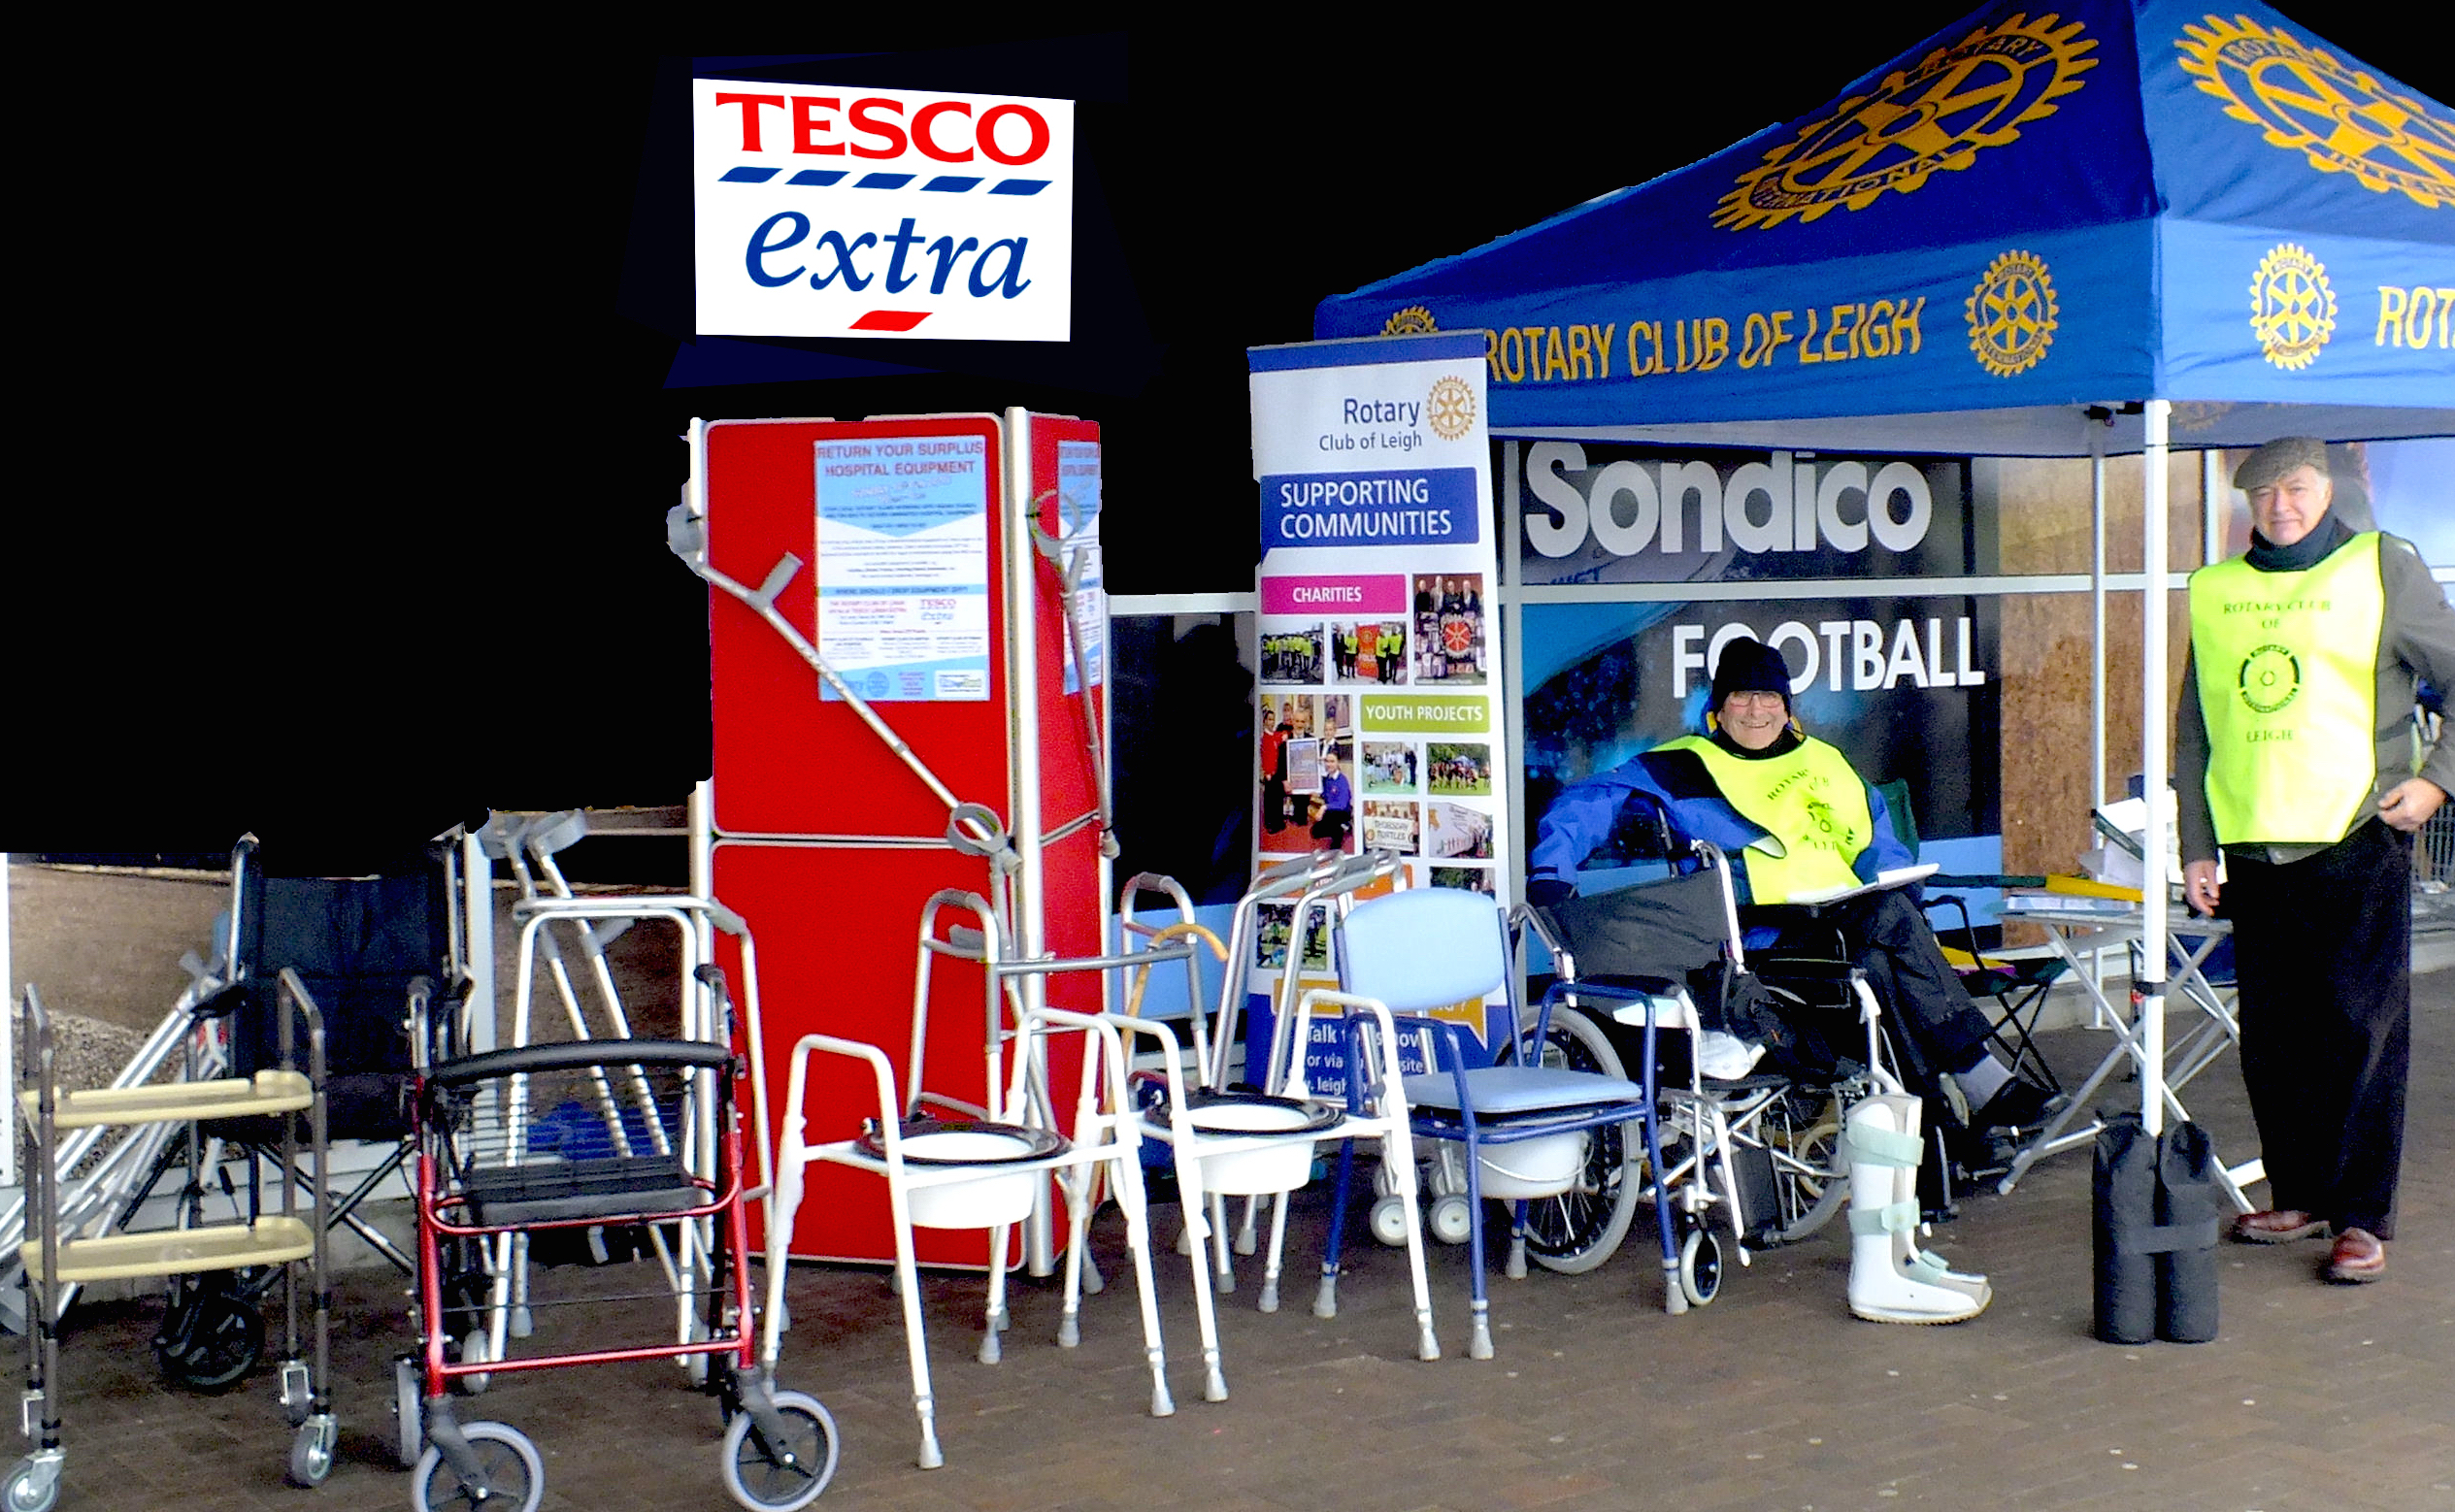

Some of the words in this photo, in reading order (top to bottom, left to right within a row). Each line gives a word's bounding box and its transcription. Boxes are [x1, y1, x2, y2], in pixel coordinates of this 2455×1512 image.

[715, 92, 1050, 166] TESCO
[746, 211, 1032, 300] extra
[2375, 285, 2455, 349] ROT
[1628, 318, 1729, 377] CLUB
[1738, 311, 1794, 369] OF
[1800, 296, 1926, 364] LEIGH
[1344, 398, 1421, 427] Rotary
[817, 444, 872, 459] RETURN
[876, 443, 914, 457] YOUR
[917, 441, 983, 456] SURPLUS
[1319, 434, 1355, 451] Club
[1360, 432, 1377, 448] of
[1380, 430, 1422, 452] Leigh
[825, 463, 889, 477] HOSPITAL
[894, 460, 976, 475] EQUIPMENT
[1279, 478, 1430, 508] SUPPORTING
[1525, 441, 1932, 558] Sondico
[1279, 509, 1453, 539] COMMUNITIES
[1292, 586, 1363, 604] CHARITIES
[1365, 705, 1413, 721] YOUTH
[1417, 706, 1483, 722] PROJECTS
[1307, 1055, 1320, 1067] or
[1323, 1053, 1344, 1068] via
